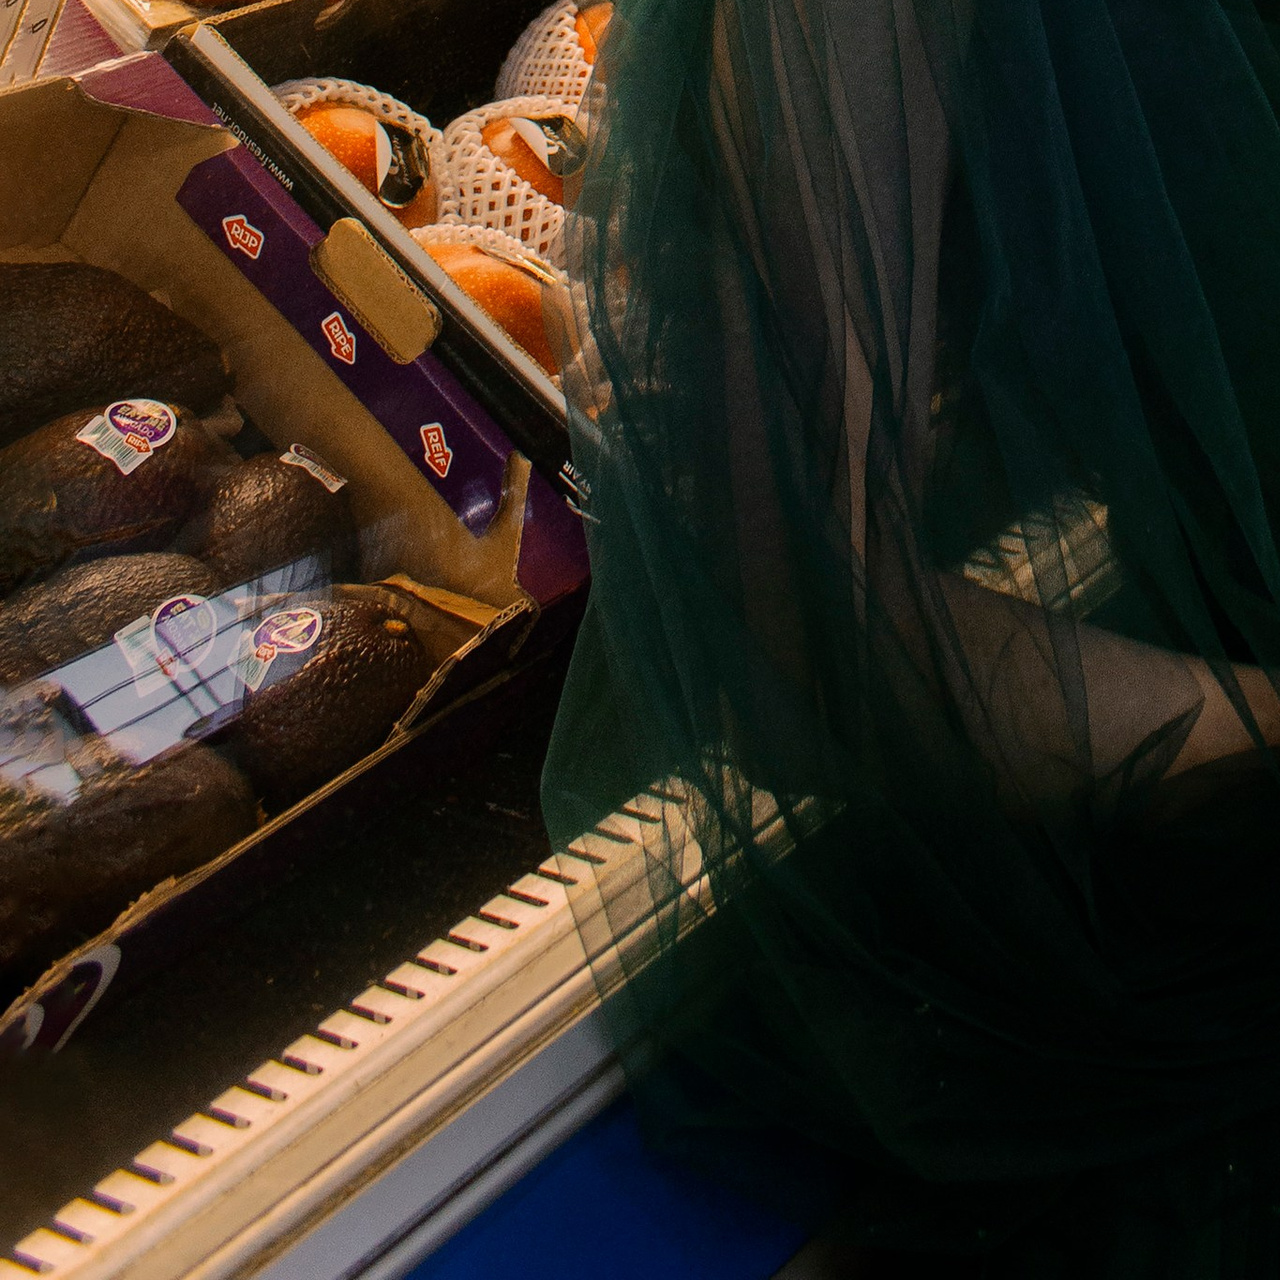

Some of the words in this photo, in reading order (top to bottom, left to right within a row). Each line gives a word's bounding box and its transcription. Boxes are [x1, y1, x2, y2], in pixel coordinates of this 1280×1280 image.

[212, 102, 294, 191] www.freshdor.net
[231, 222, 258, 248] RIJP
[329, 321, 352, 356] RIPE
[128, 436, 148, 452] RIPE
[428, 431, 446, 467] REIF
